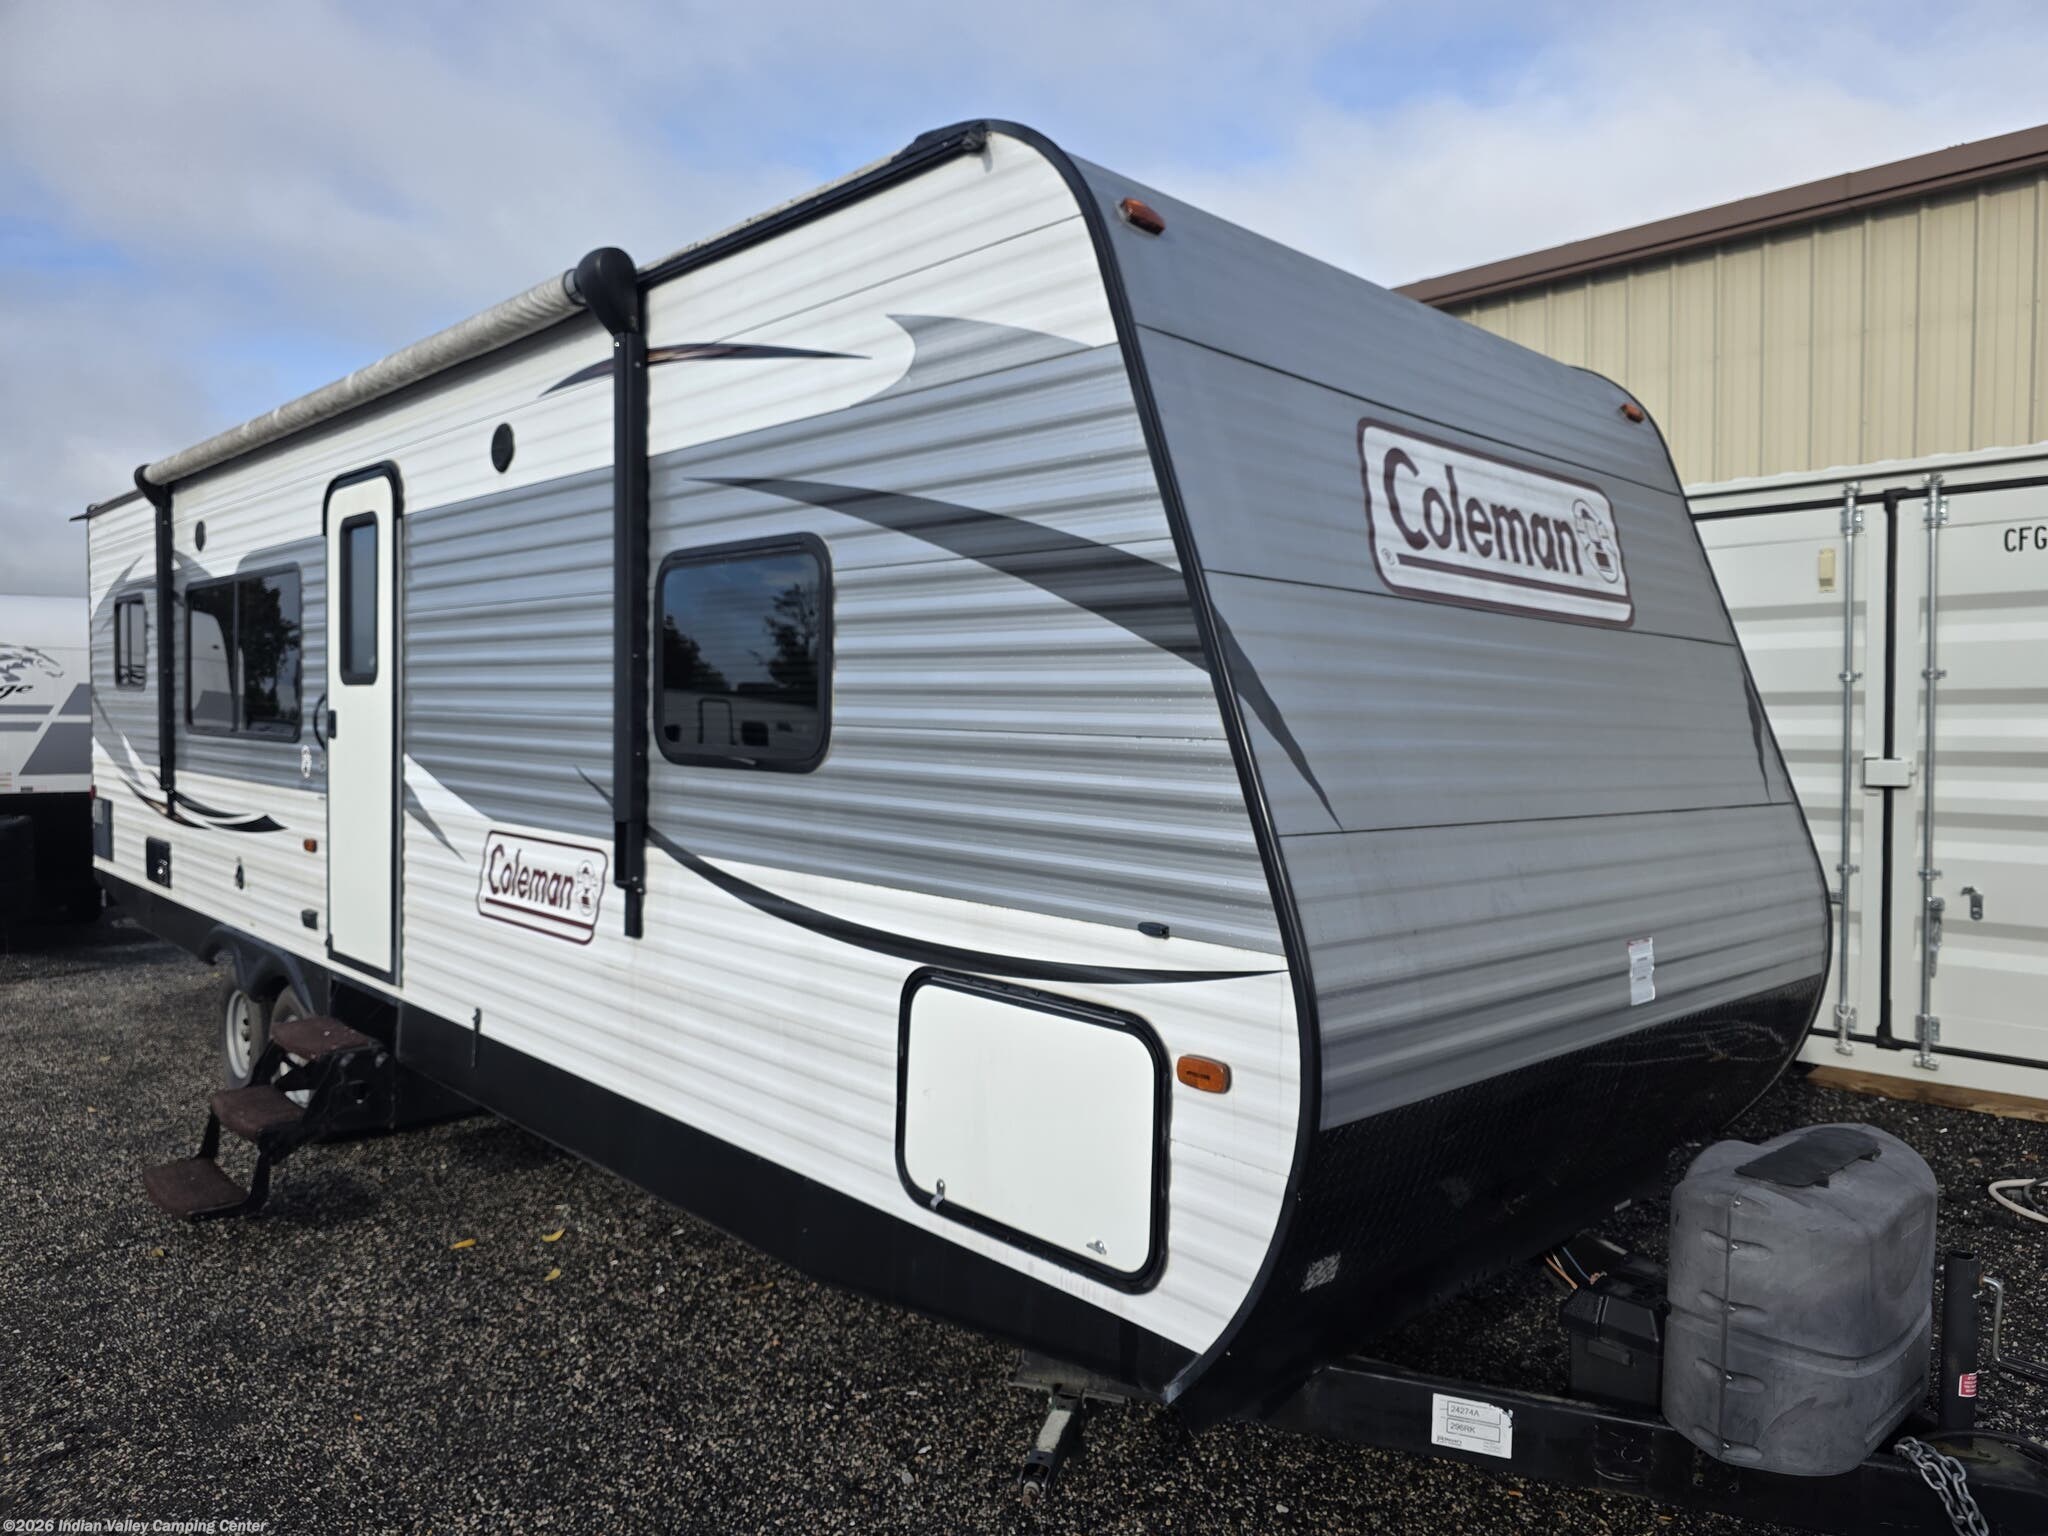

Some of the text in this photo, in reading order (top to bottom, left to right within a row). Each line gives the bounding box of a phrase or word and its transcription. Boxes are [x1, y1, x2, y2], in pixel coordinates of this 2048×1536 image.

[1384, 447, 1583, 576] Coleman
[2004, 525, 2048, 552] CFG
[489, 843, 574, 910] Coleman
